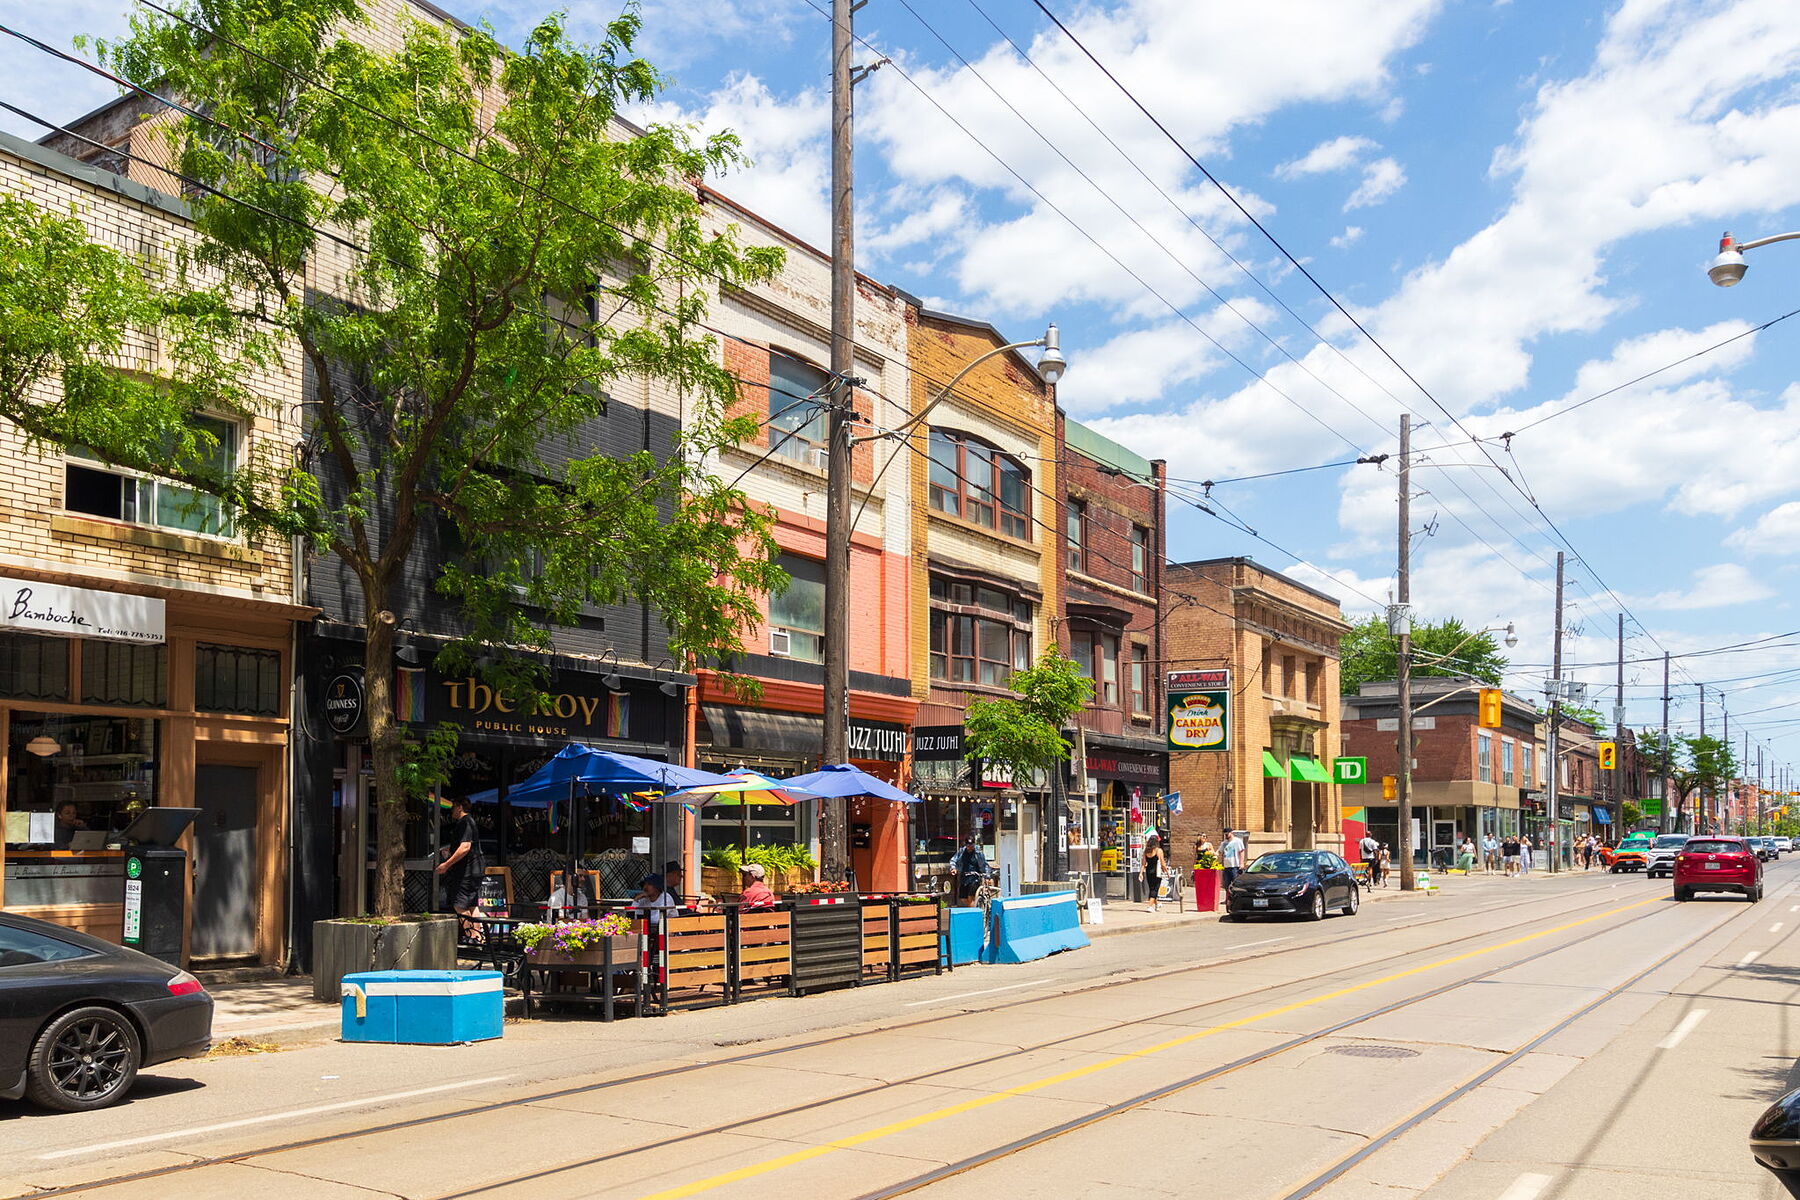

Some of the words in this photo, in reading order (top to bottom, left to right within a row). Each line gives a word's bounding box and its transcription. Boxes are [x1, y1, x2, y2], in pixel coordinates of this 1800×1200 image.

[9, 588, 92, 627] Bamboche
[327, 698, 357, 710] GUINNESS
[1187, 709, 1209, 717] Drink
[476, 720, 522, 732] PUBLIC
[528, 725, 568, 736] HOUSE
[1175, 718, 1219, 728] CANADA
[1185, 728, 1210, 738] DRY
[875, 728, 907, 754] SUSHI
[915, 736, 934, 750] JUZZ
[936, 735, 959, 750] SUSHI
[1336, 761, 1362, 779] TD
